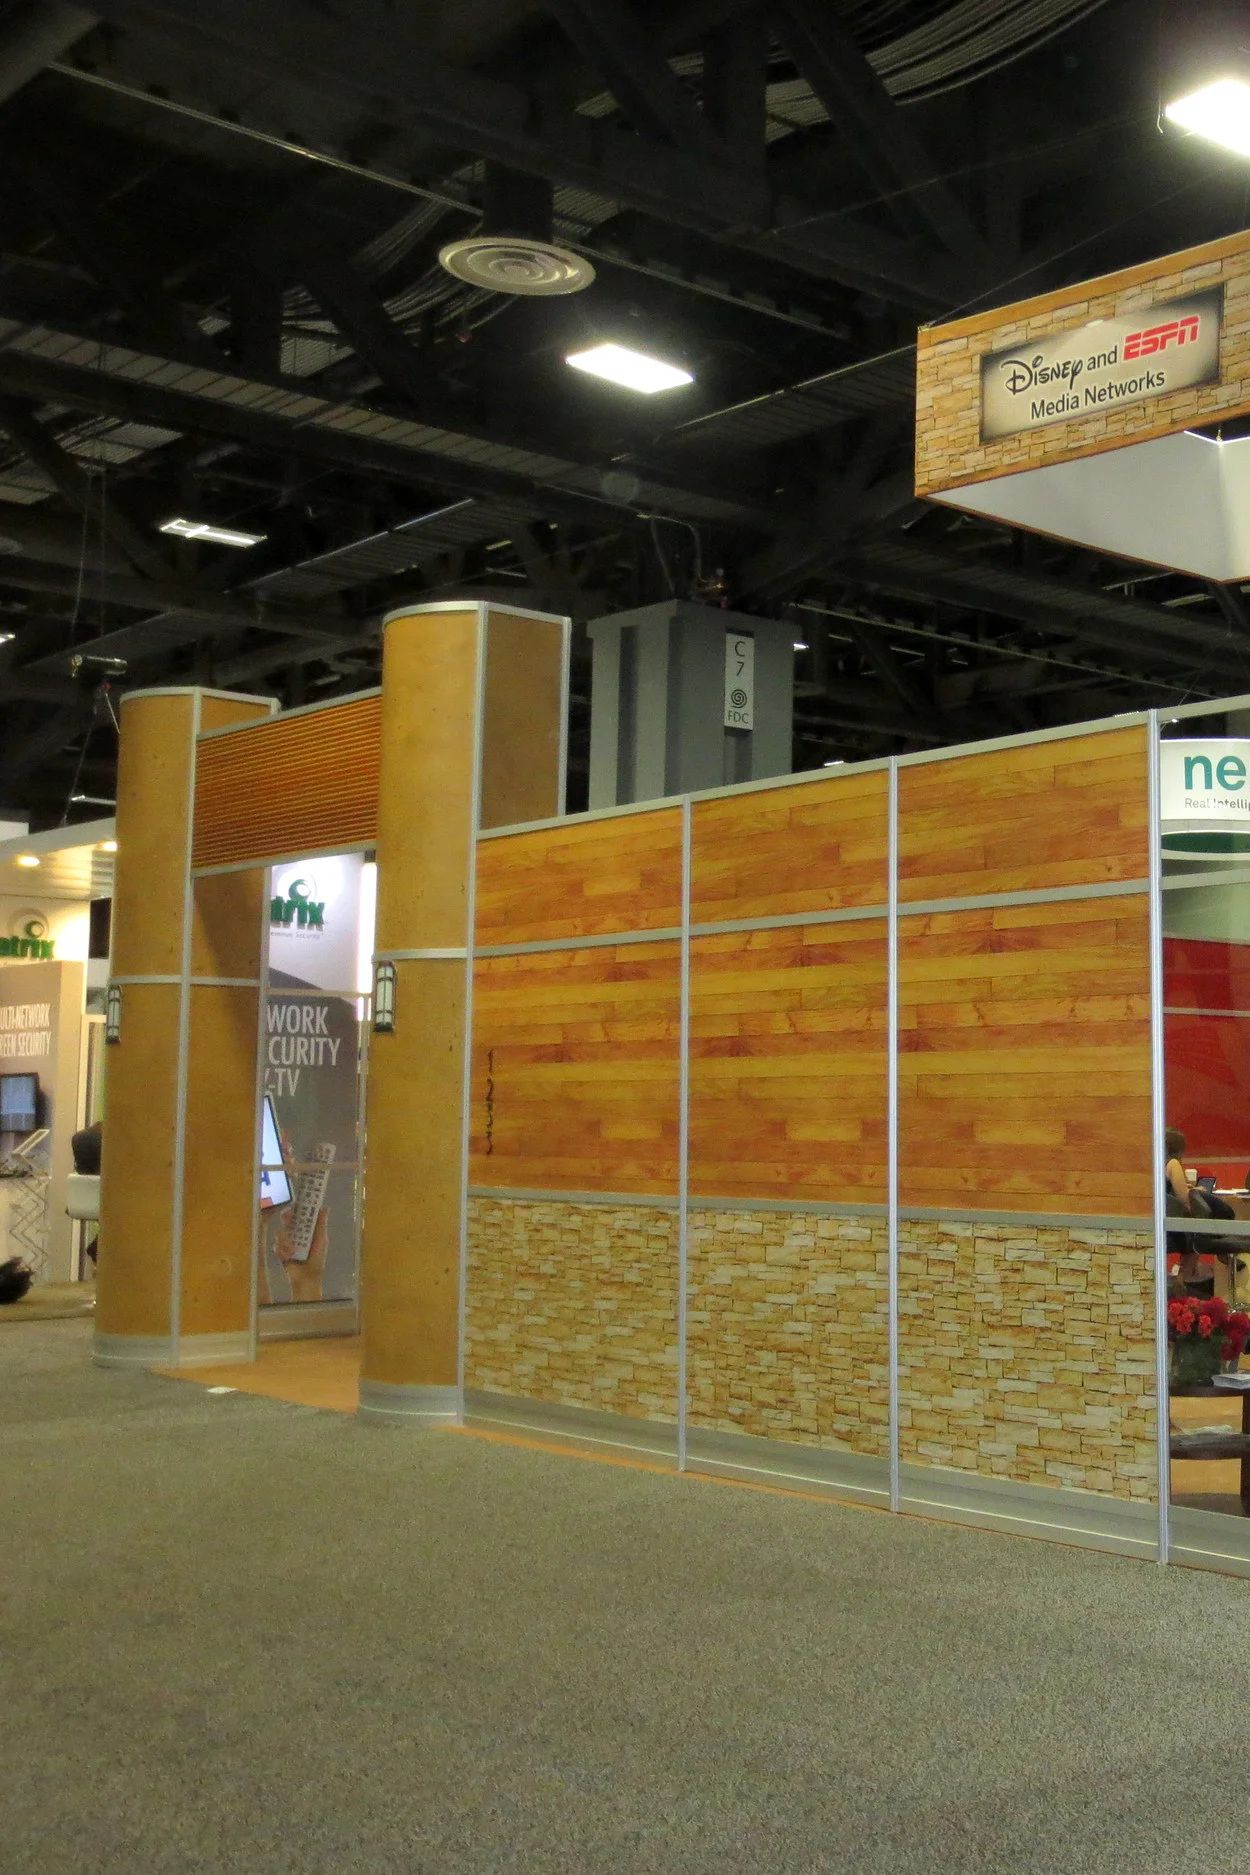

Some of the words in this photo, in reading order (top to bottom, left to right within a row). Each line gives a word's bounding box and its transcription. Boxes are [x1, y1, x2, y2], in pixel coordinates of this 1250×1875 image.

[1087, 345, 1118, 371] and
[1123, 316, 1200, 361] ESPN
[1031, 394, 1079, 420] Media
[1085, 370, 1166, 406] Networks
[1184, 797, 1210, 809] Real
[266, 1004, 329, 1034] WORK
[268, 1035, 341, 1067] CURITY
